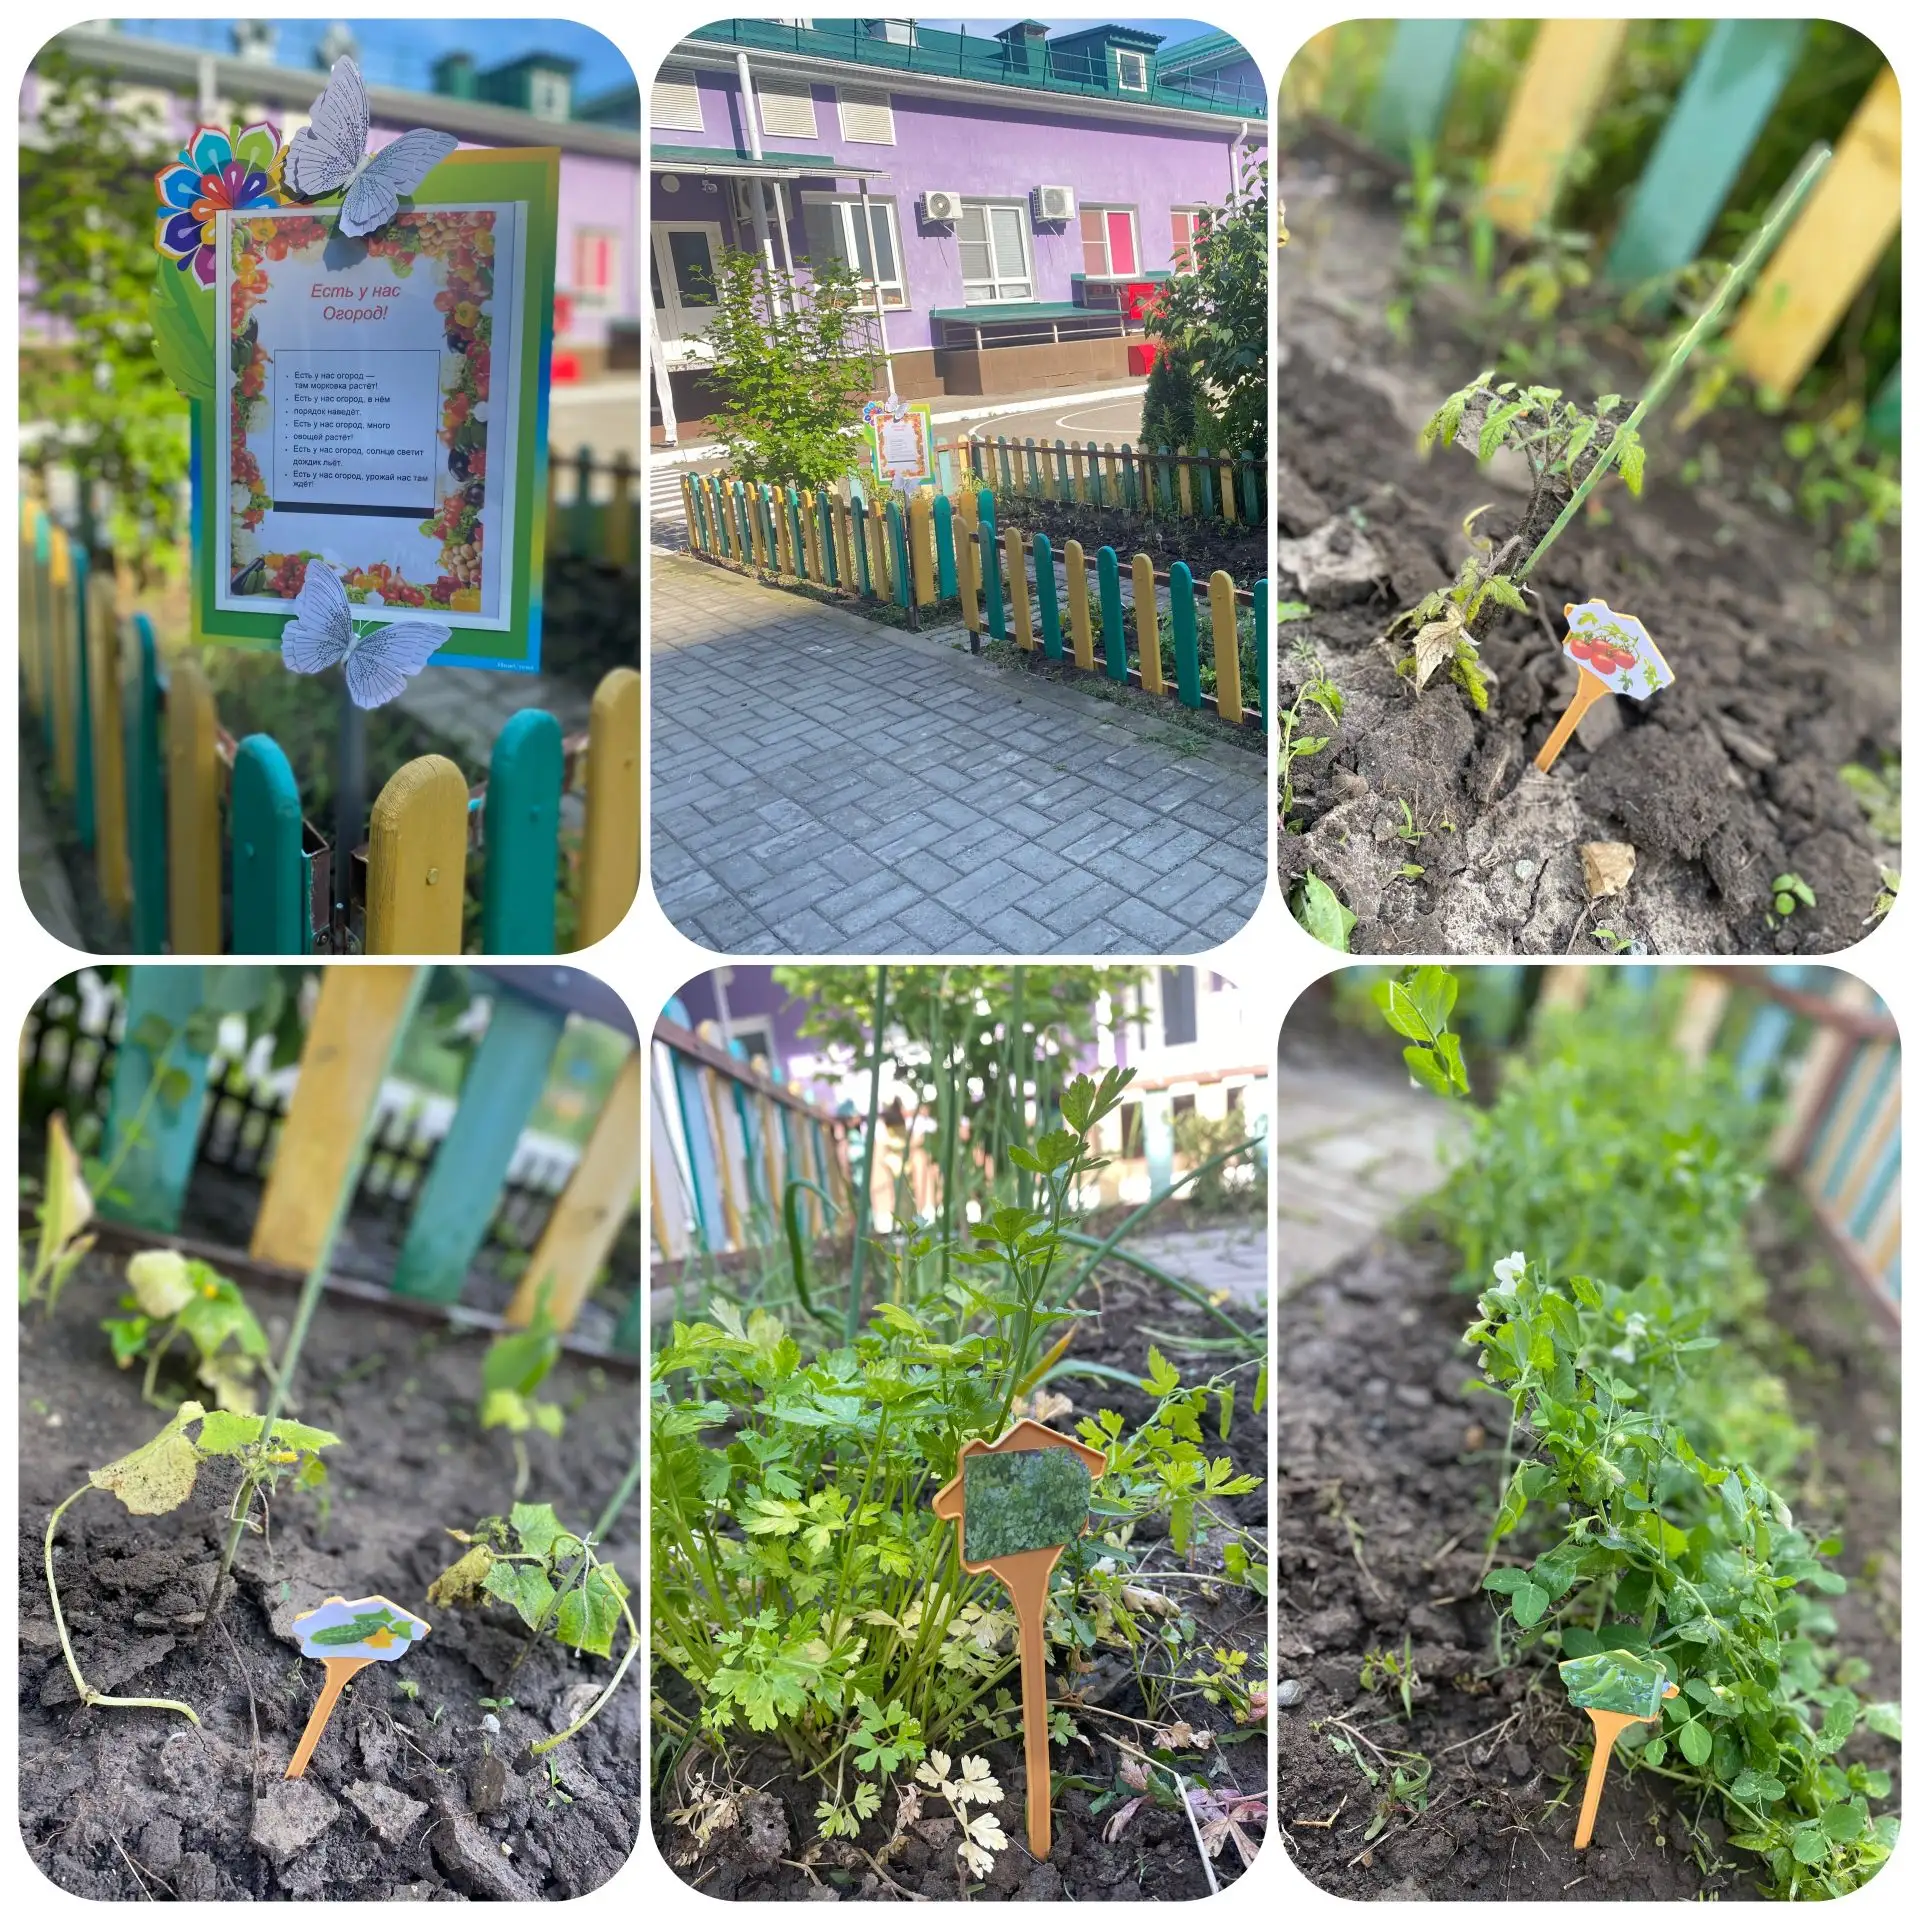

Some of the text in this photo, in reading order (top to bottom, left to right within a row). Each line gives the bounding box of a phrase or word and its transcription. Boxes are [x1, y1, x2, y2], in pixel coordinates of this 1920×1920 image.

[311, 283, 401, 301] Есть у нас
[323, 305, 388, 324] Огород!
[294, 371, 314, 380] Есть
[294, 394, 312, 402] Есть
[293, 470, 311, 478] Есть
[366, 473, 395, 481] урожай
